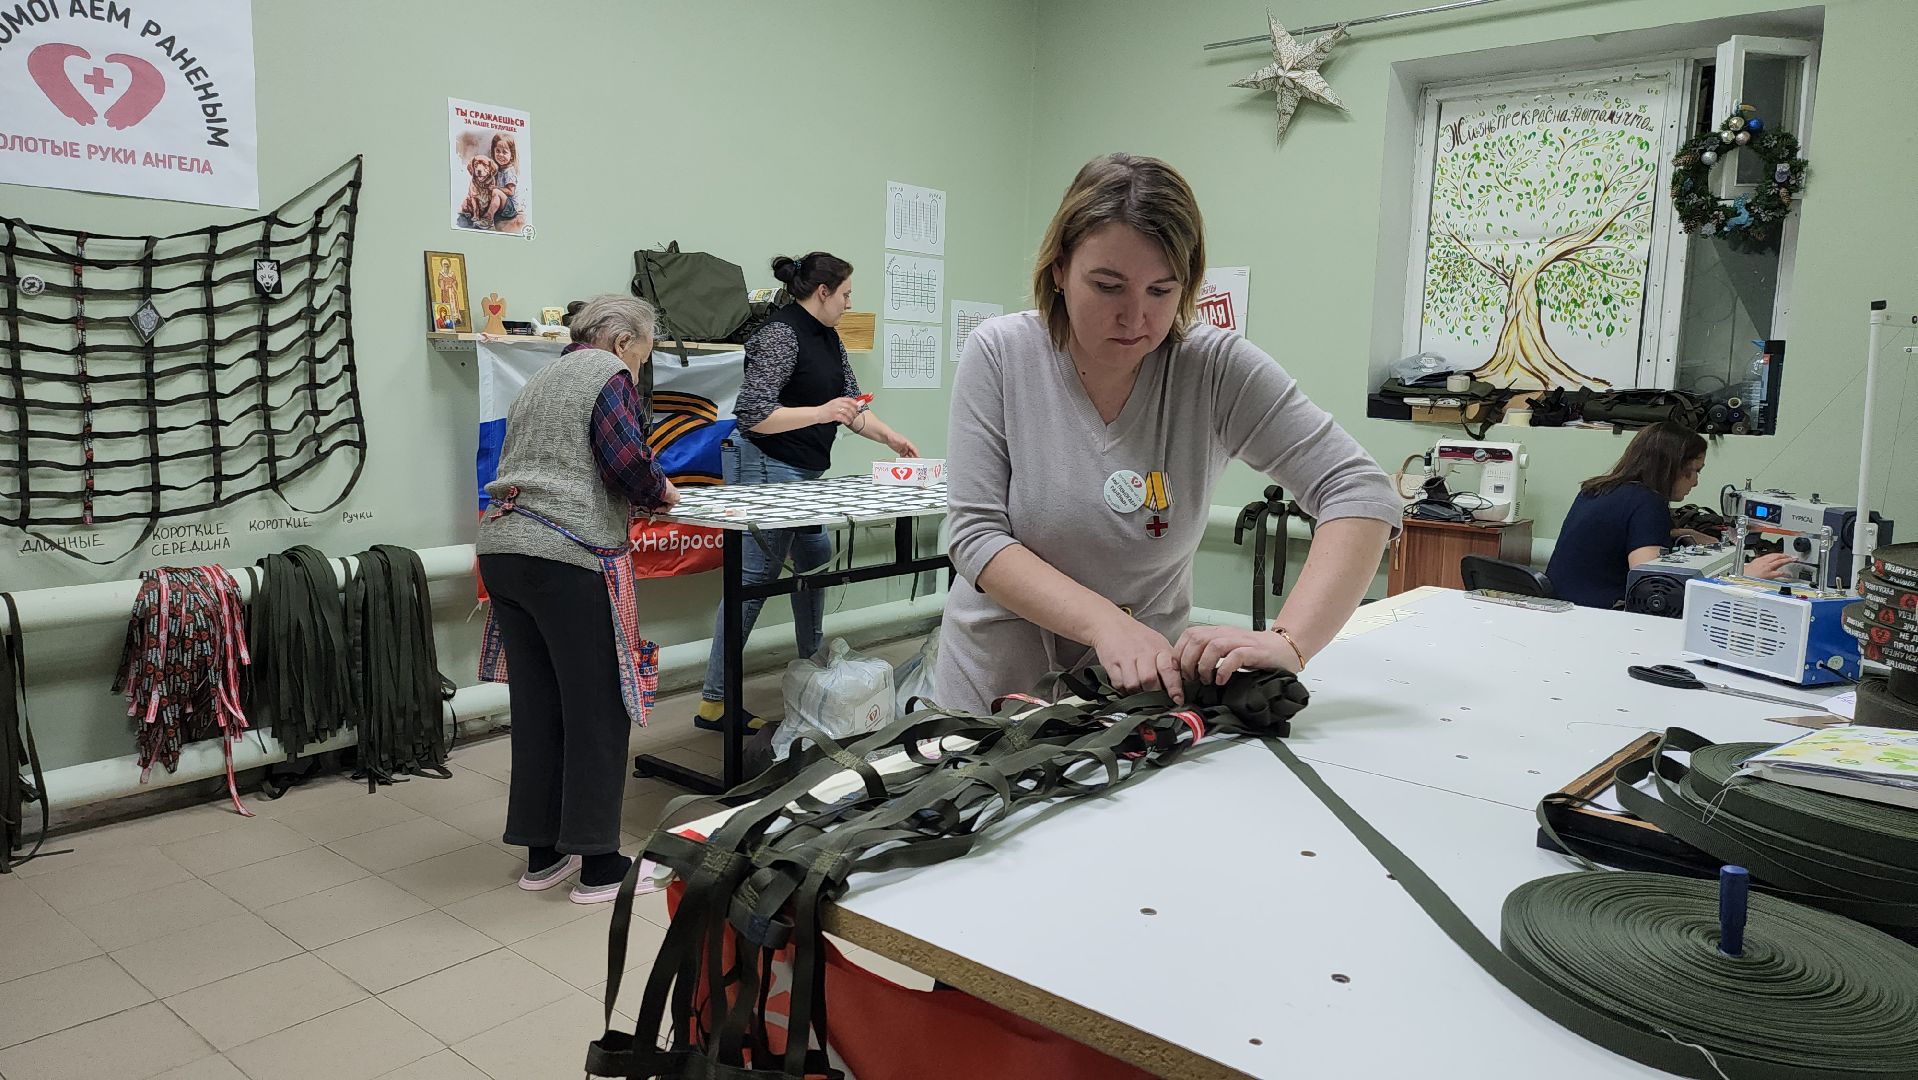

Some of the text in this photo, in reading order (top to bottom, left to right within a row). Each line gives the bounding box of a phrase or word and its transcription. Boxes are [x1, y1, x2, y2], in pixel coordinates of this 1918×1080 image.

[0, 0, 229, 147] ОМОГАЕМ РАНЕНЫМ
[455, 107, 525, 128] ТЫ СРАЖАЕШЬСЯ
[0, 132, 214, 175] ОЛОТЫЕ РУКИ АНГЕЛА
[249, 517, 312, 531] КОРОТКИЕ
[342, 511, 373, 523] Ручки
[1791, 514, 1814, 524] TYPICAL
[152, 522, 229, 541] КОРОТКИЕ
[19, 533, 105, 555] ДЛИННЫЕ
[151, 536, 231, 557] СЕРЕДИНА
